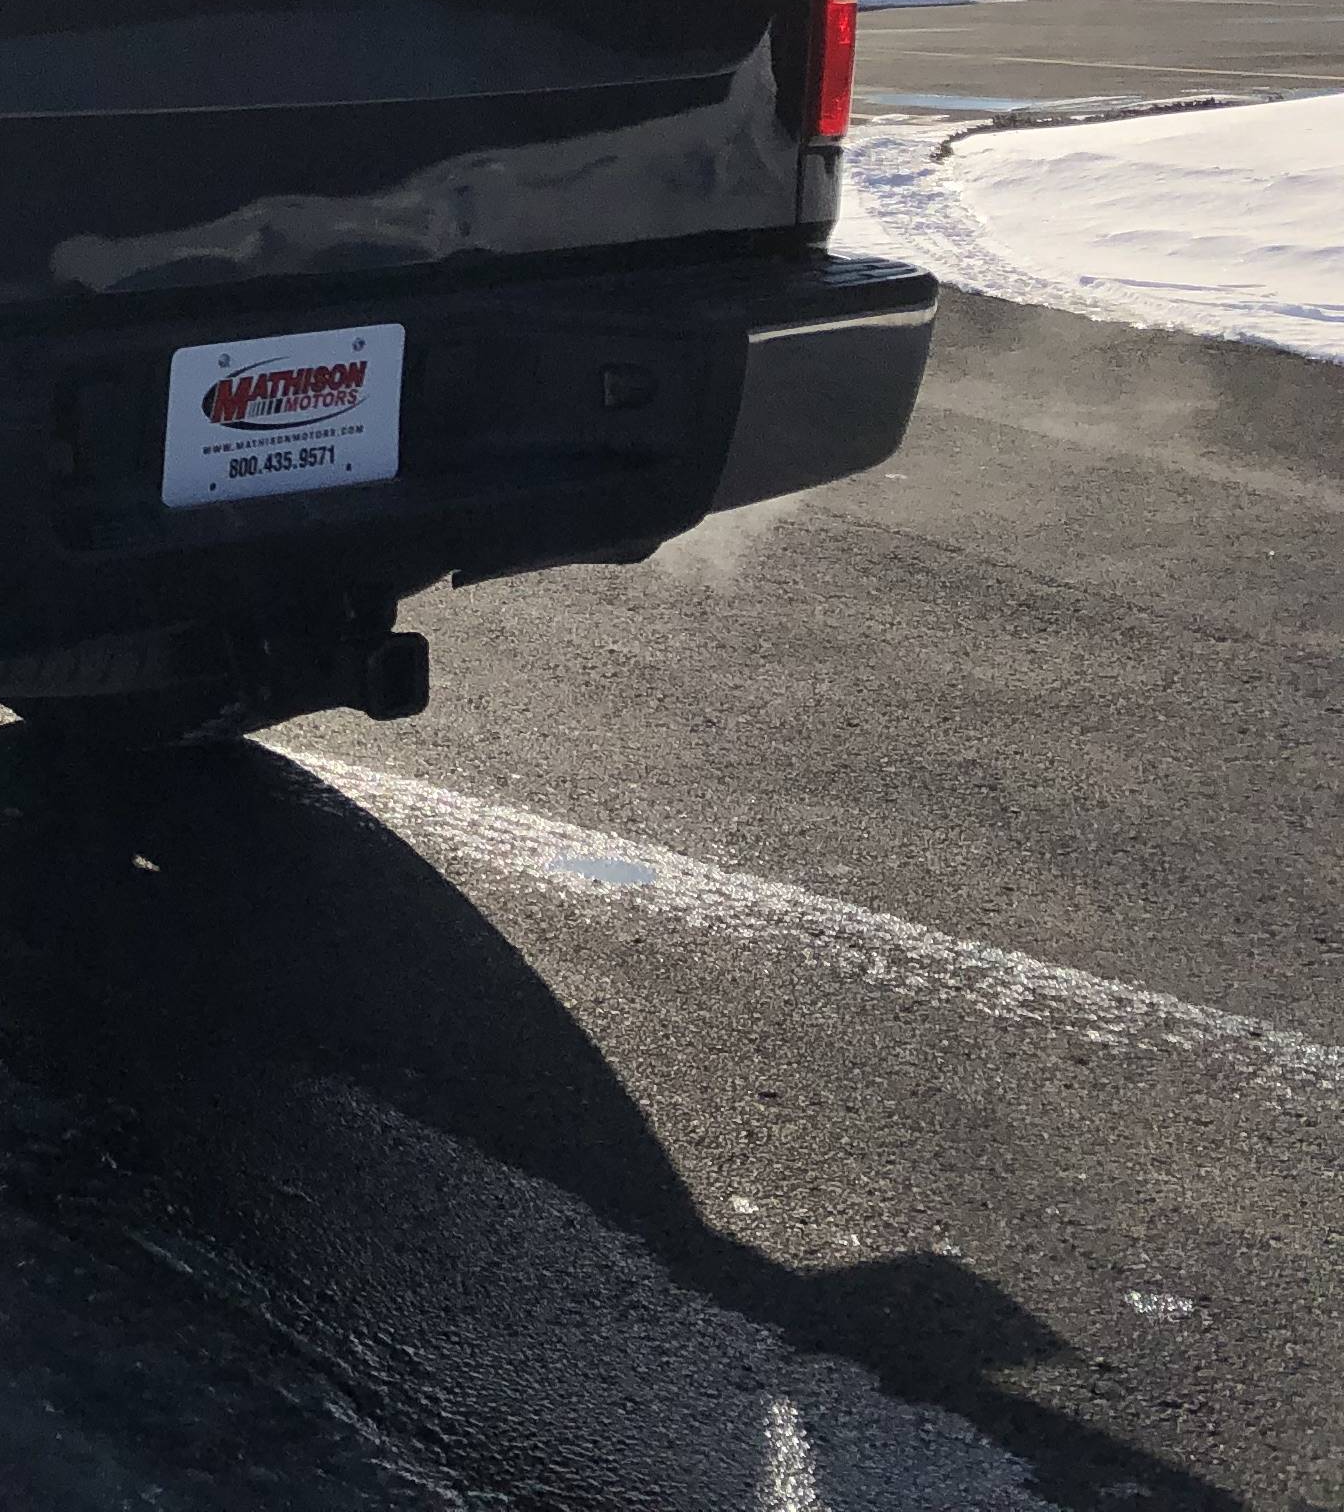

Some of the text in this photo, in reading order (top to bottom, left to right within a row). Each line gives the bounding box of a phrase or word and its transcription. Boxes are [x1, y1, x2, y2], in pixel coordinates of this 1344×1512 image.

[211, 361, 368, 423] MATHISON
[285, 389, 358, 412] MOTORS
[229, 445, 335, 478] 800.435.9571
